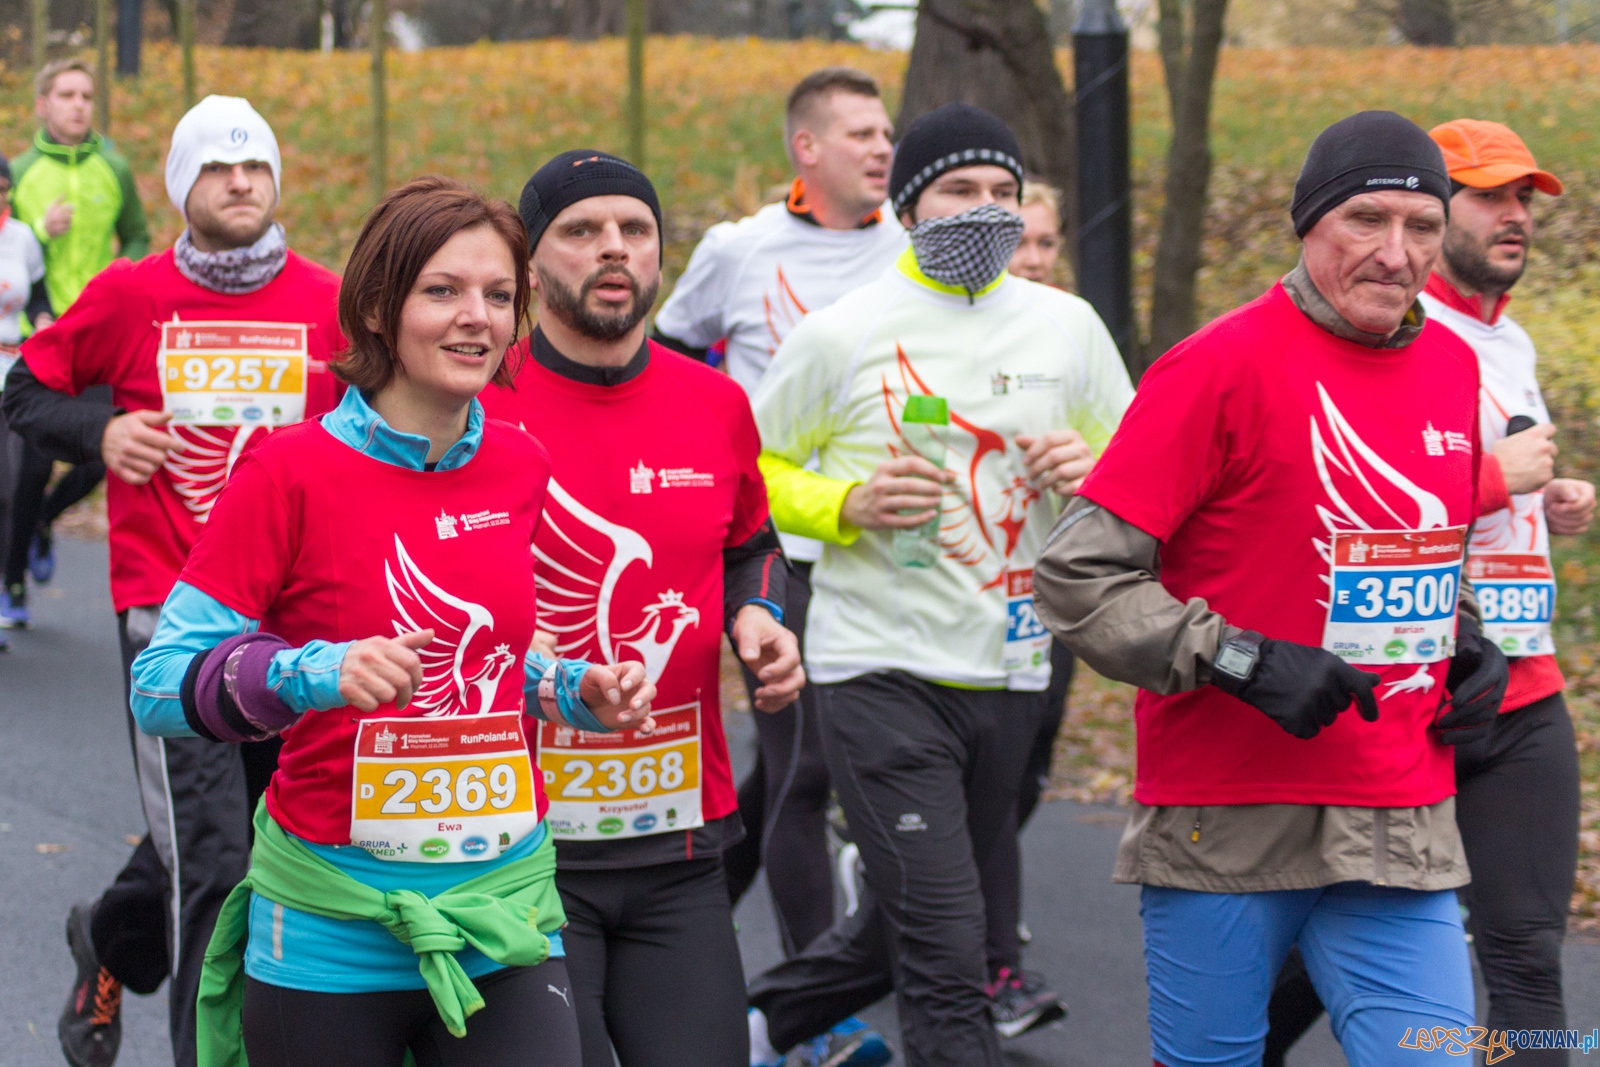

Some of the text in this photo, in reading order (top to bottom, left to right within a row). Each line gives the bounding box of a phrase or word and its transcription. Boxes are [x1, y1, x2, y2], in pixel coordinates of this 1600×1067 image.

[1366, 178, 1405, 186] ARTENGO
[168, 367, 179, 380] D
[182, 357, 290, 391] 9257
[460, 513, 472, 531] 1
[1337, 573, 1455, 618] E 3500
[1477, 586, 1548, 621] 8891
[1393, 626, 1425, 634] Marian
[400, 733, 409, 749] 1
[460, 730, 519, 744] RunPoland.org
[543, 750, 685, 798] D 2368
[360, 763, 517, 815] D 2369
[599, 801, 649, 815] Krzysztof
[437, 822, 462, 832] Ewa
[359, 840, 391, 848] GRUPA
